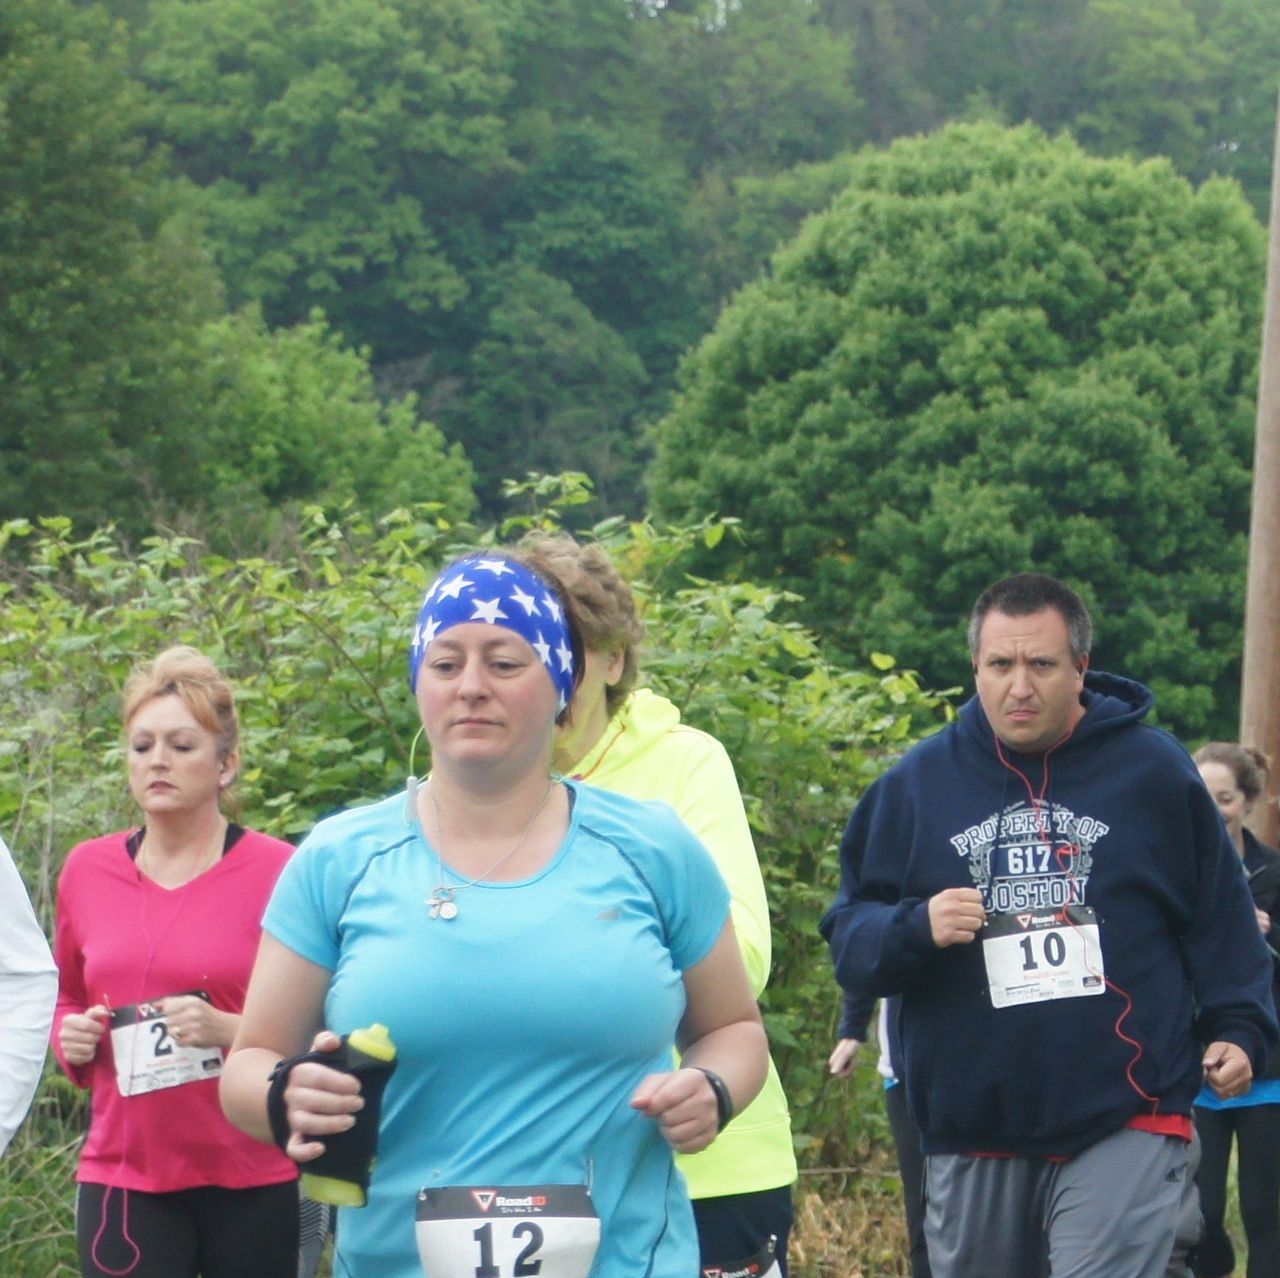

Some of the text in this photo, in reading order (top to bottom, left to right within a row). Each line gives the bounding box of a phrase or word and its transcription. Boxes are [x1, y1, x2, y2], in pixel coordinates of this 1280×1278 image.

[951, 811, 1110, 856] PROPERTY OF
[1007, 845, 1052, 874] 617
[977, 877, 1087, 912] BOSTON
[1020, 932, 1066, 971] 10
[495, 1196, 547, 1207] RoadID
[473, 1221, 545, 1278] 12
